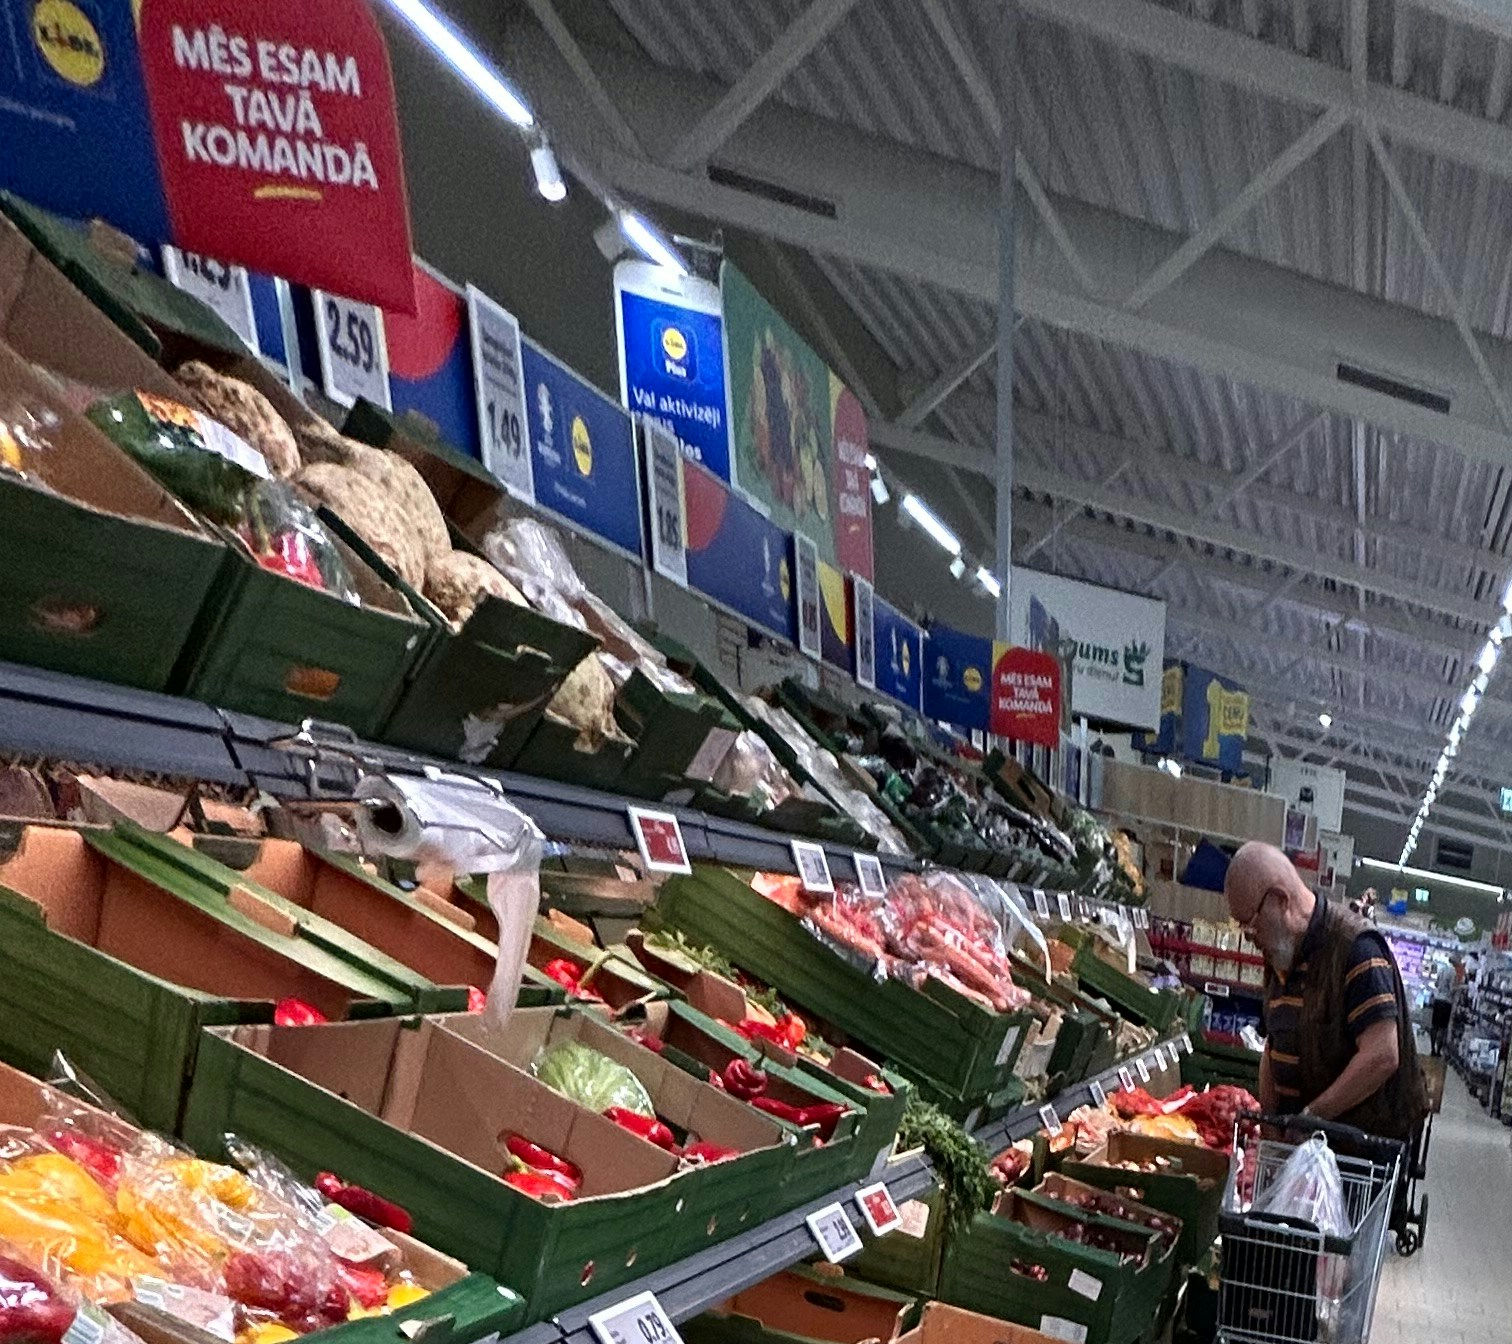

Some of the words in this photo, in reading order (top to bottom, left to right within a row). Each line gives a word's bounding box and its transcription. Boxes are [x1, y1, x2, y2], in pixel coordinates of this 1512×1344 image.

[172, 23, 252, 77] MĒS
[256, 39, 361, 97] ESAM
[224, 83, 323, 138] TAVĀ
[181, 119, 379, 190] KOMANDĀ
[636, 1311, 667, 1344] 0.79
